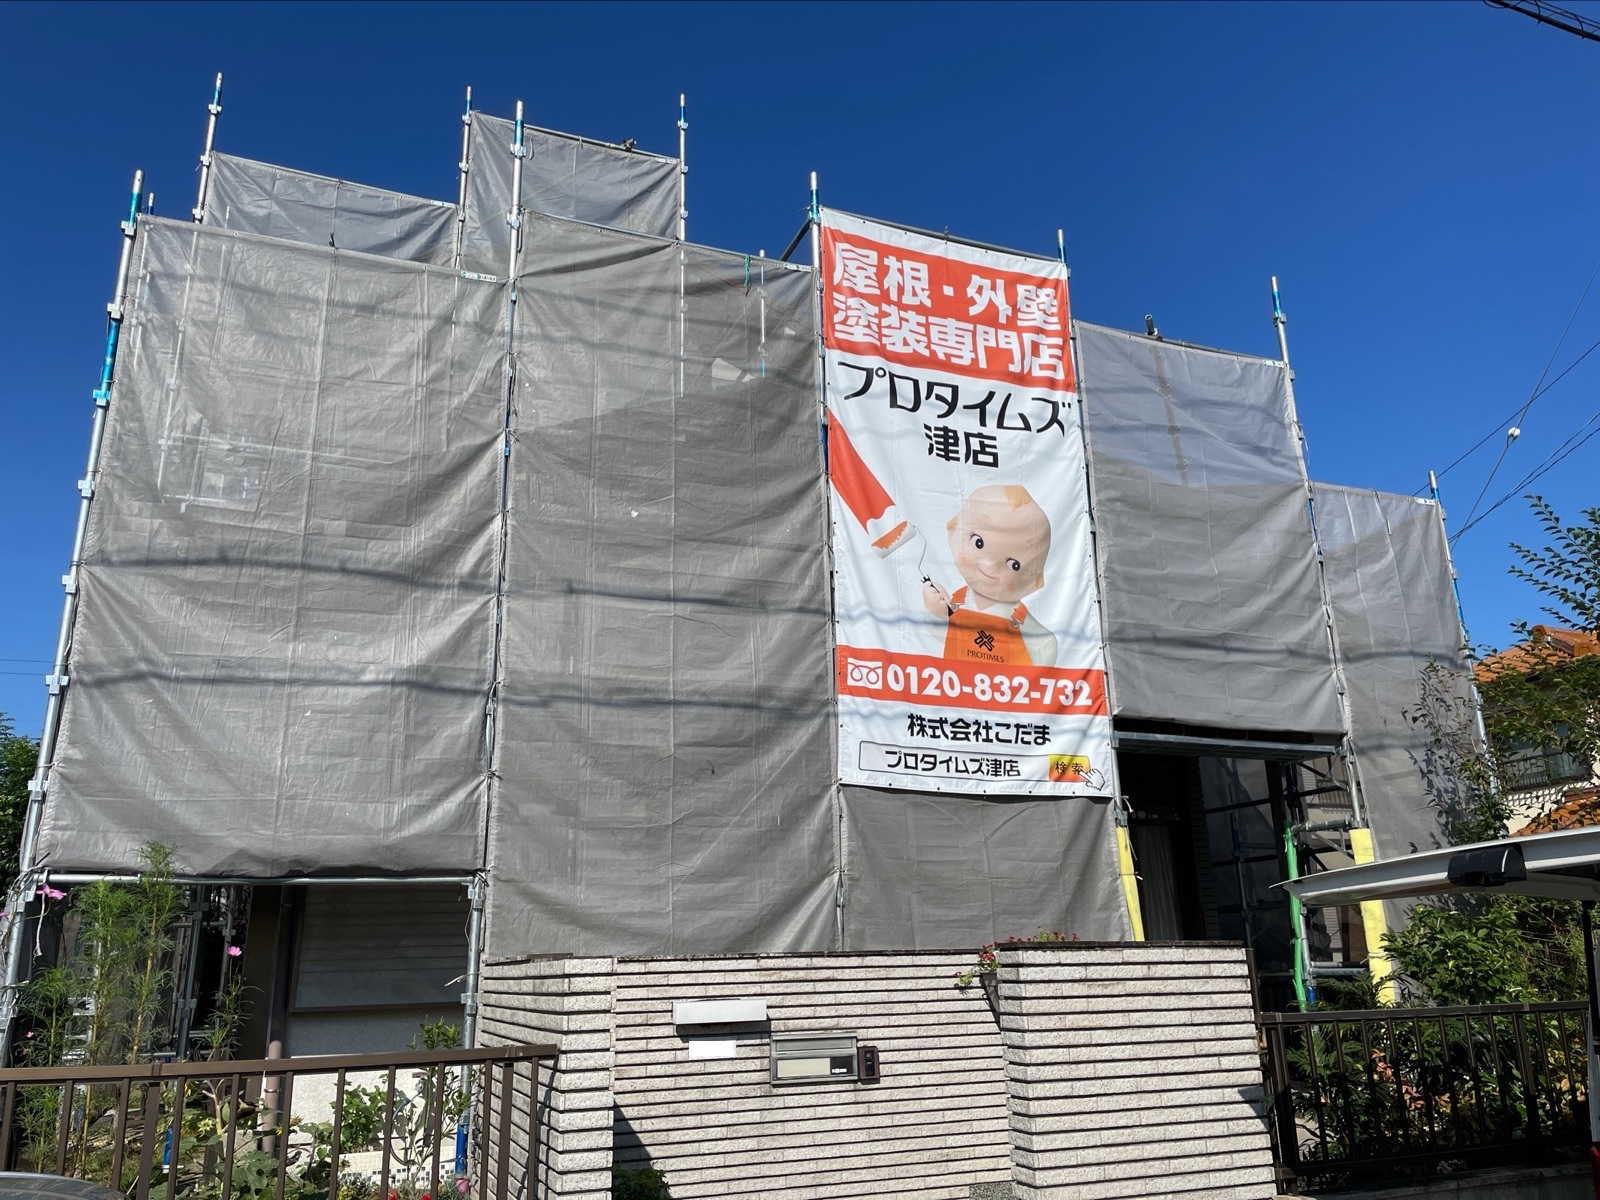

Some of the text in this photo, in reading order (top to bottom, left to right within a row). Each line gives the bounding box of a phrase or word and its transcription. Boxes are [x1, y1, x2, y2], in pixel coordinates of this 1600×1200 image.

[833, 242, 1061, 331] 屋根・外壁
[833, 292, 1065, 380] 塗装専門店
[838, 361, 1072, 437] プロタイムズ
[924, 423, 999, 468] 津店
[967, 649, 1005, 663] PROTIMES
[887, 663, 1092, 706] 0120-832-732
[907, 713, 1052, 745] 株式会社こだま
[885, 750, 1021, 777] プロタイムズ津店
[1055, 761, 1084, 775] 検索
